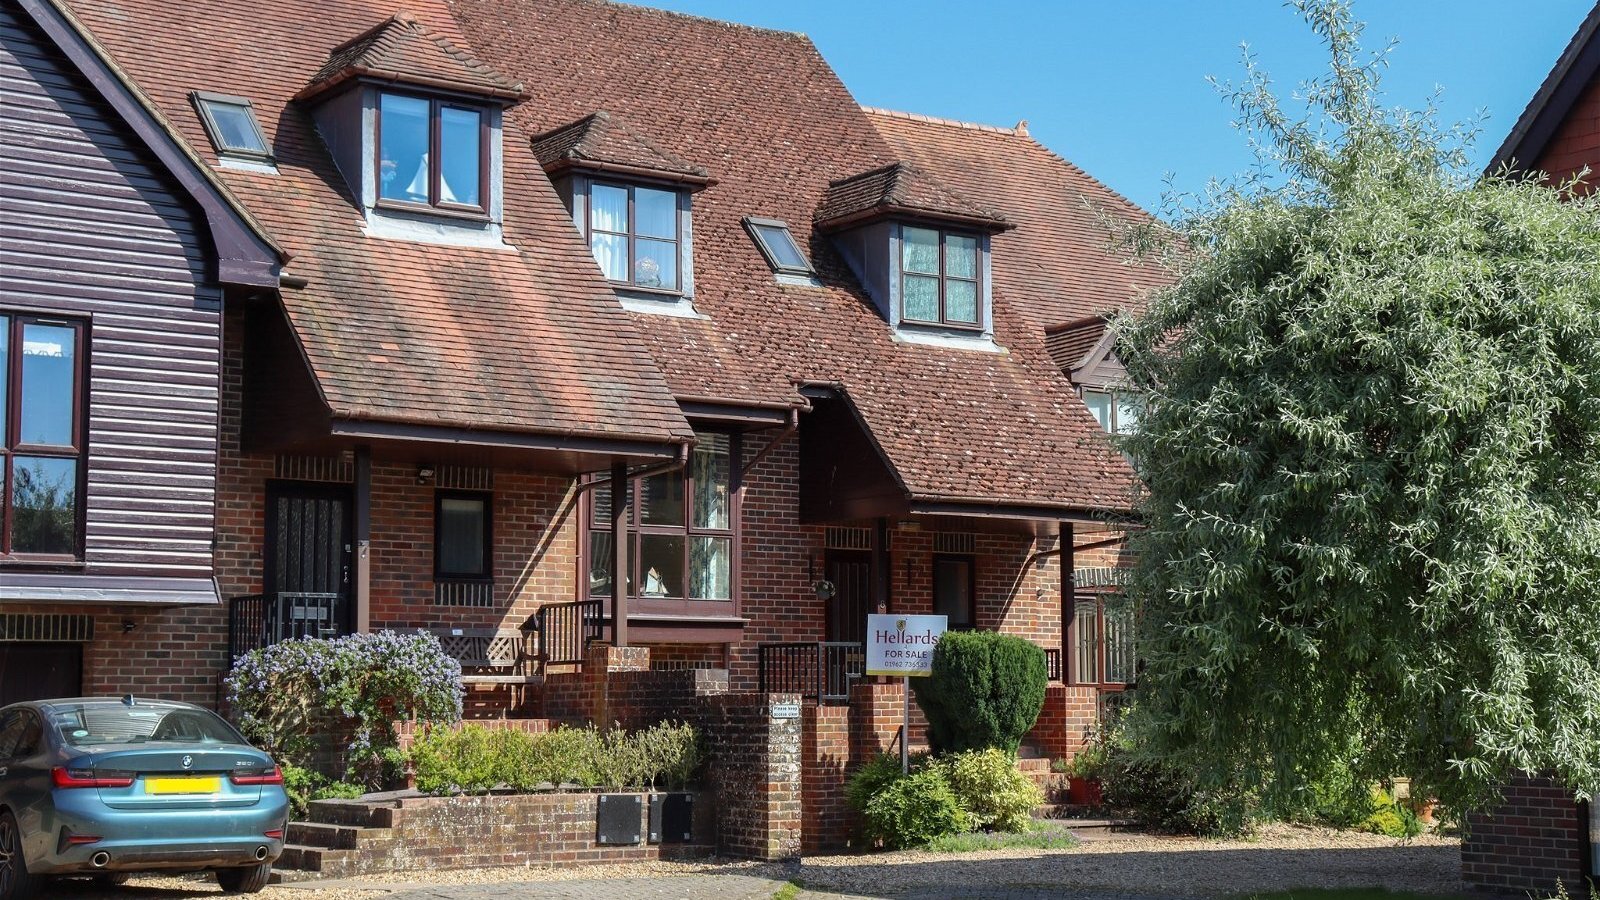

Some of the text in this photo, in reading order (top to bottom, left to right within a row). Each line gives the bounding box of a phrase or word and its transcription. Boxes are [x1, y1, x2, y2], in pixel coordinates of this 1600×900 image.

[876, 629, 938, 645] Hellards
[884, 650, 928, 659] FOR SALE
